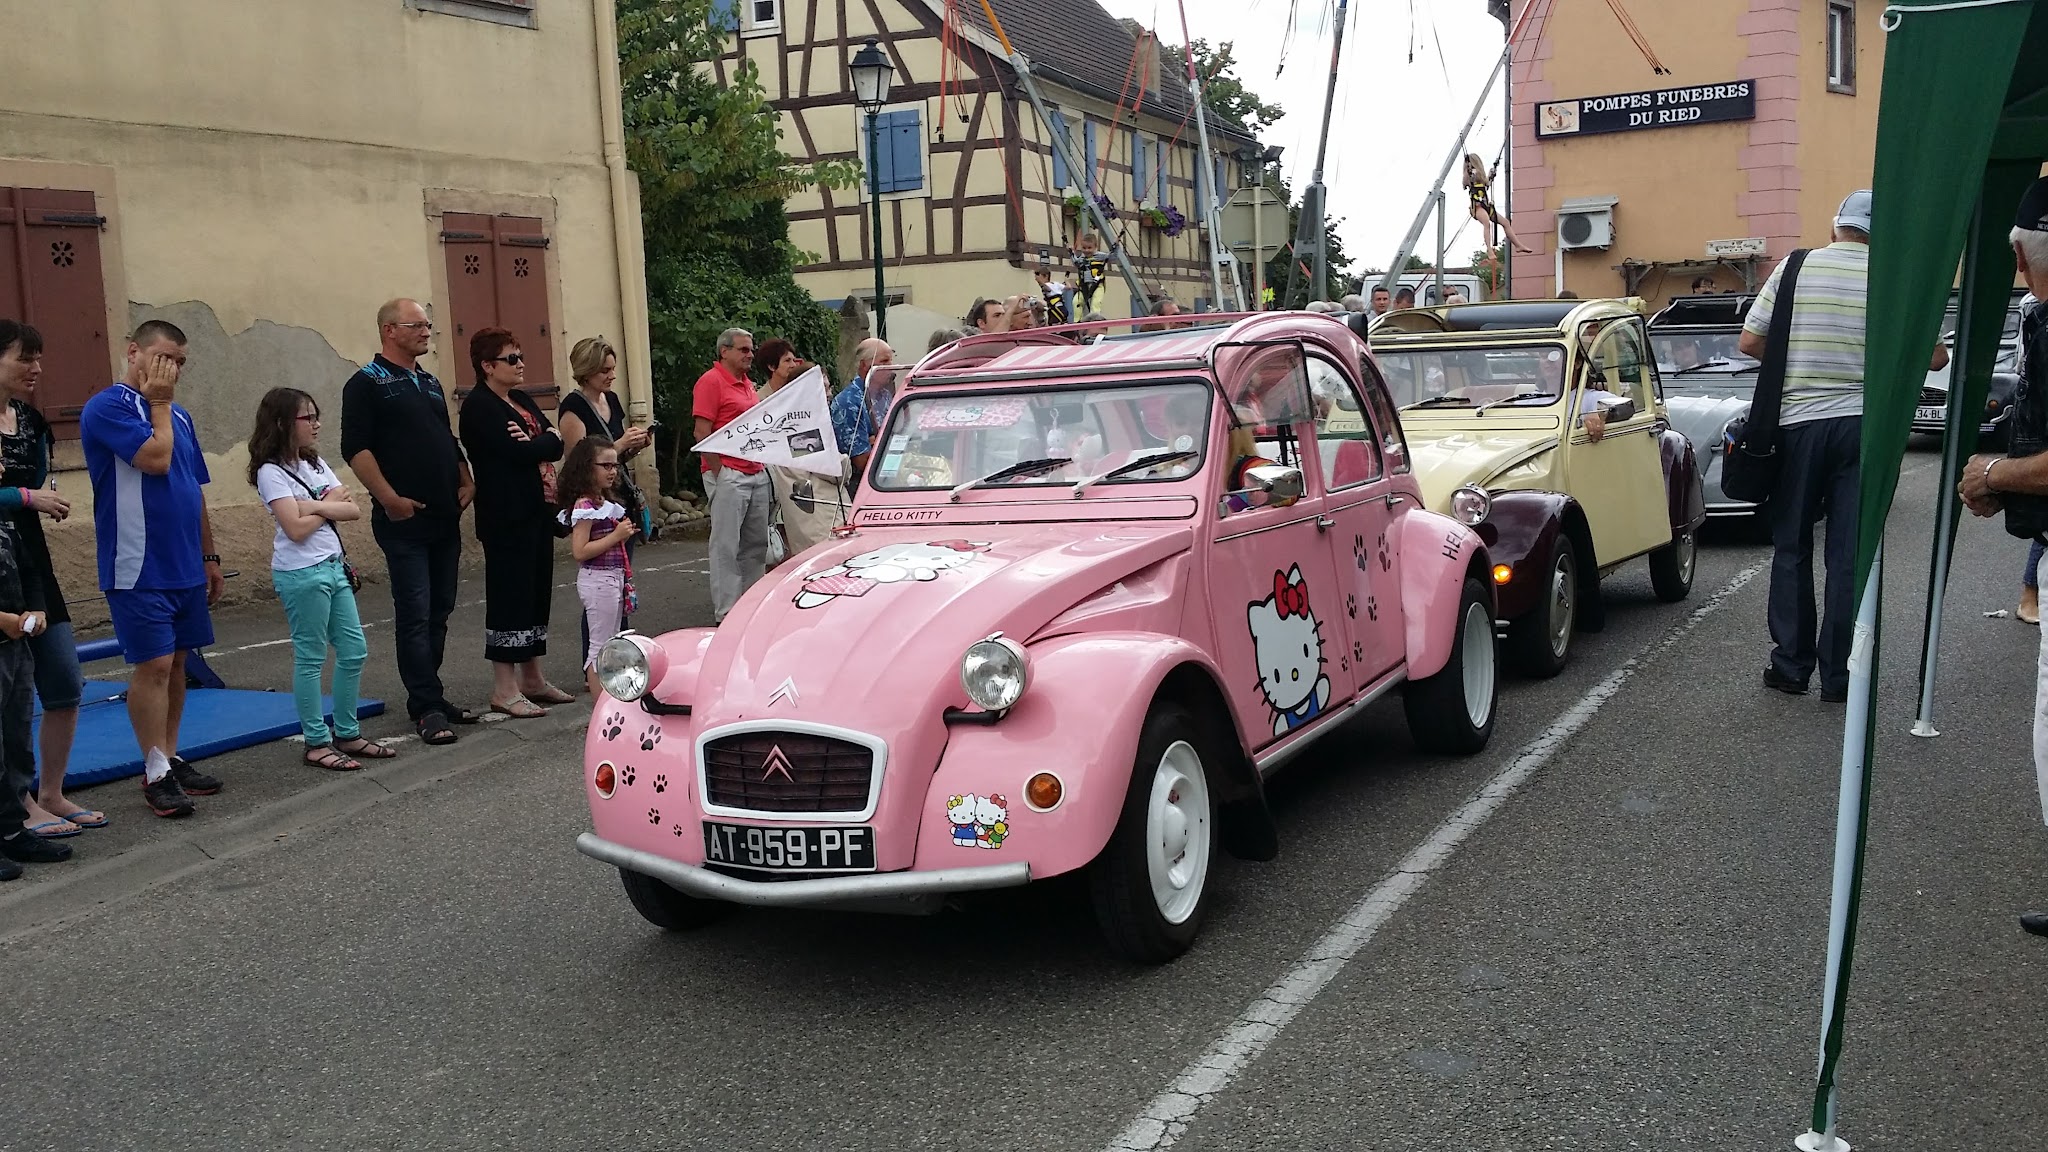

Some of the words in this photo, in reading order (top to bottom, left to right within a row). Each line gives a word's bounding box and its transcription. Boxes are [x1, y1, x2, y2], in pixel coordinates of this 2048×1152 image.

[1583, 93, 1652, 113] POMPES
[1656, 82, 1749, 106] FUNEBRES
[1629, 110, 1653, 127] DU
[1658, 106, 1702, 124] RIED
[724, 429, 734, 440] 2
[736, 422, 750, 434] CV
[787, 410, 811, 421] RHIN
[862, 511, 903, 521] HELLO
[905, 510, 943, 520] KITTY
